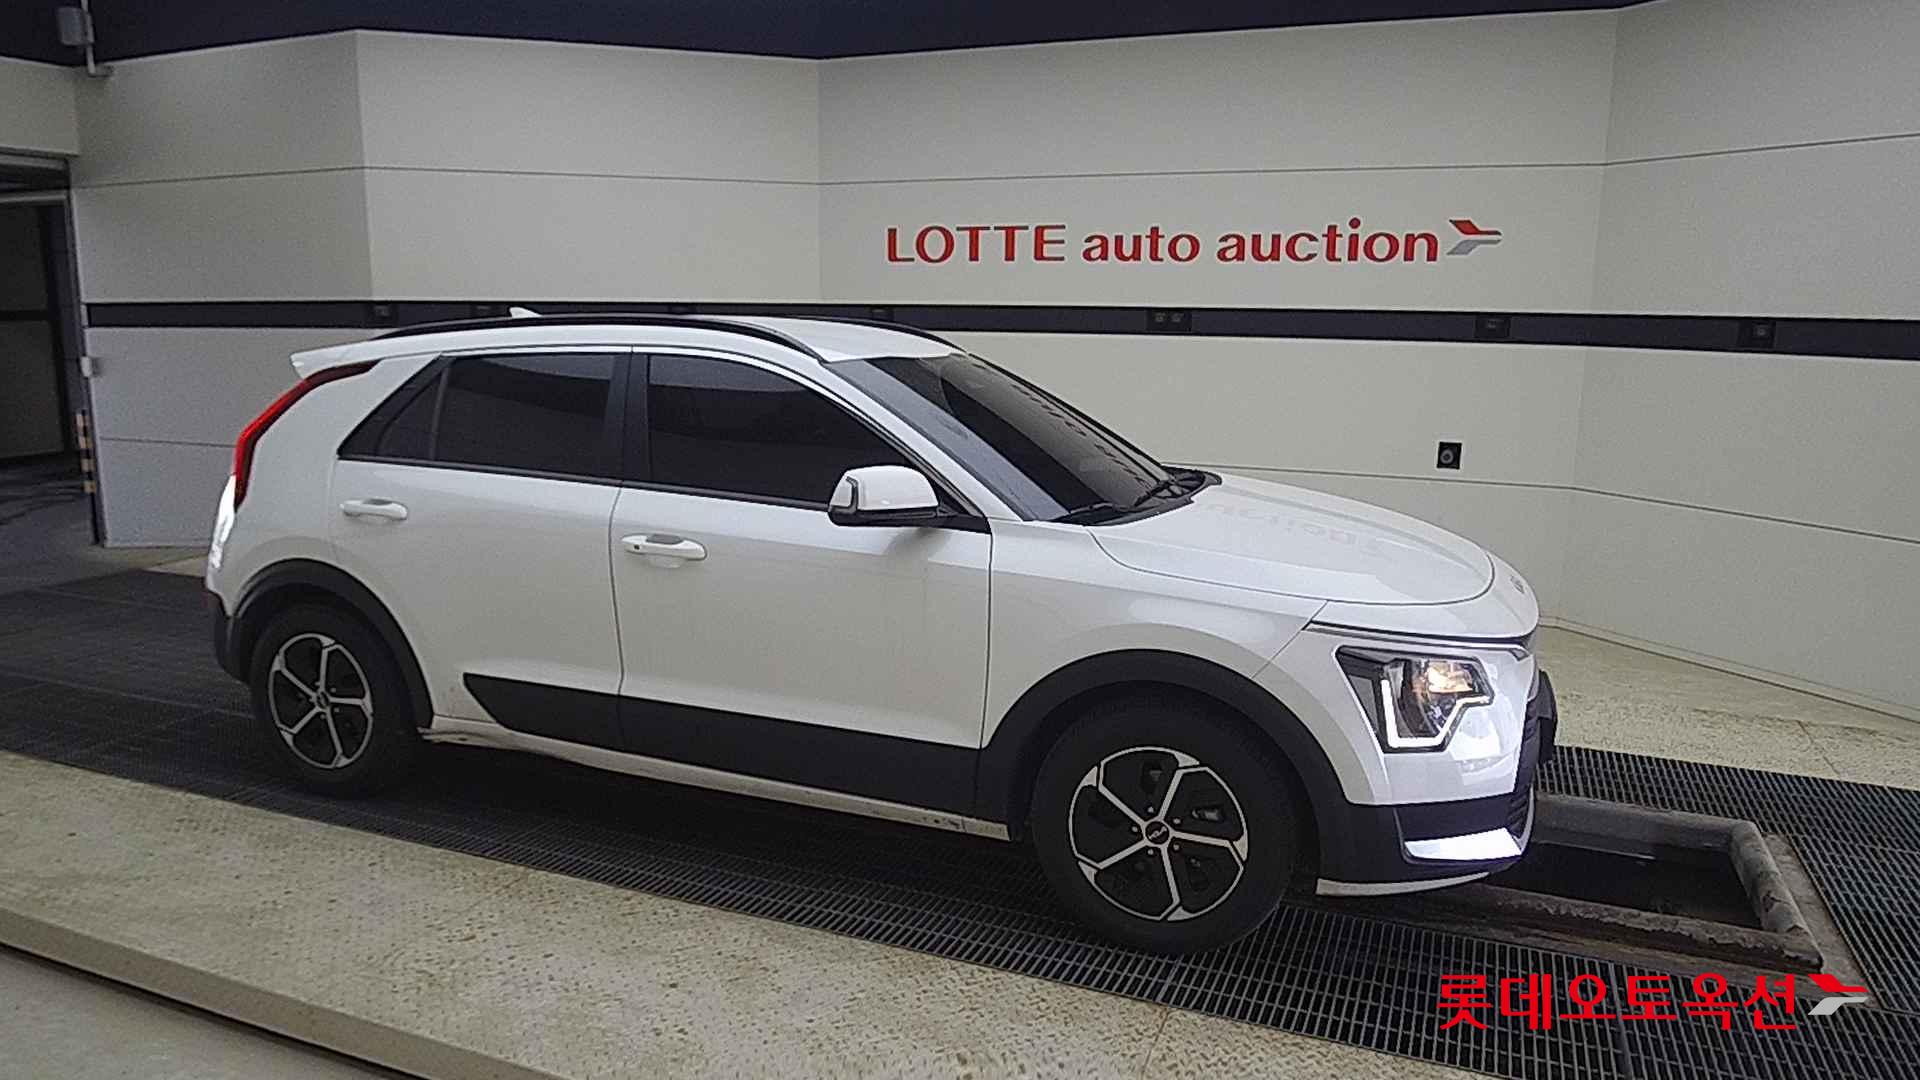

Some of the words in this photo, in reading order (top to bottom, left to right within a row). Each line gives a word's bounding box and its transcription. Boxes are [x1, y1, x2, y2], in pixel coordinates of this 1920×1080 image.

[887, 225, 1066, 262] LOTTE
[1081, 227, 1200, 262] auto
[1216, 218, 1439, 262] auction
